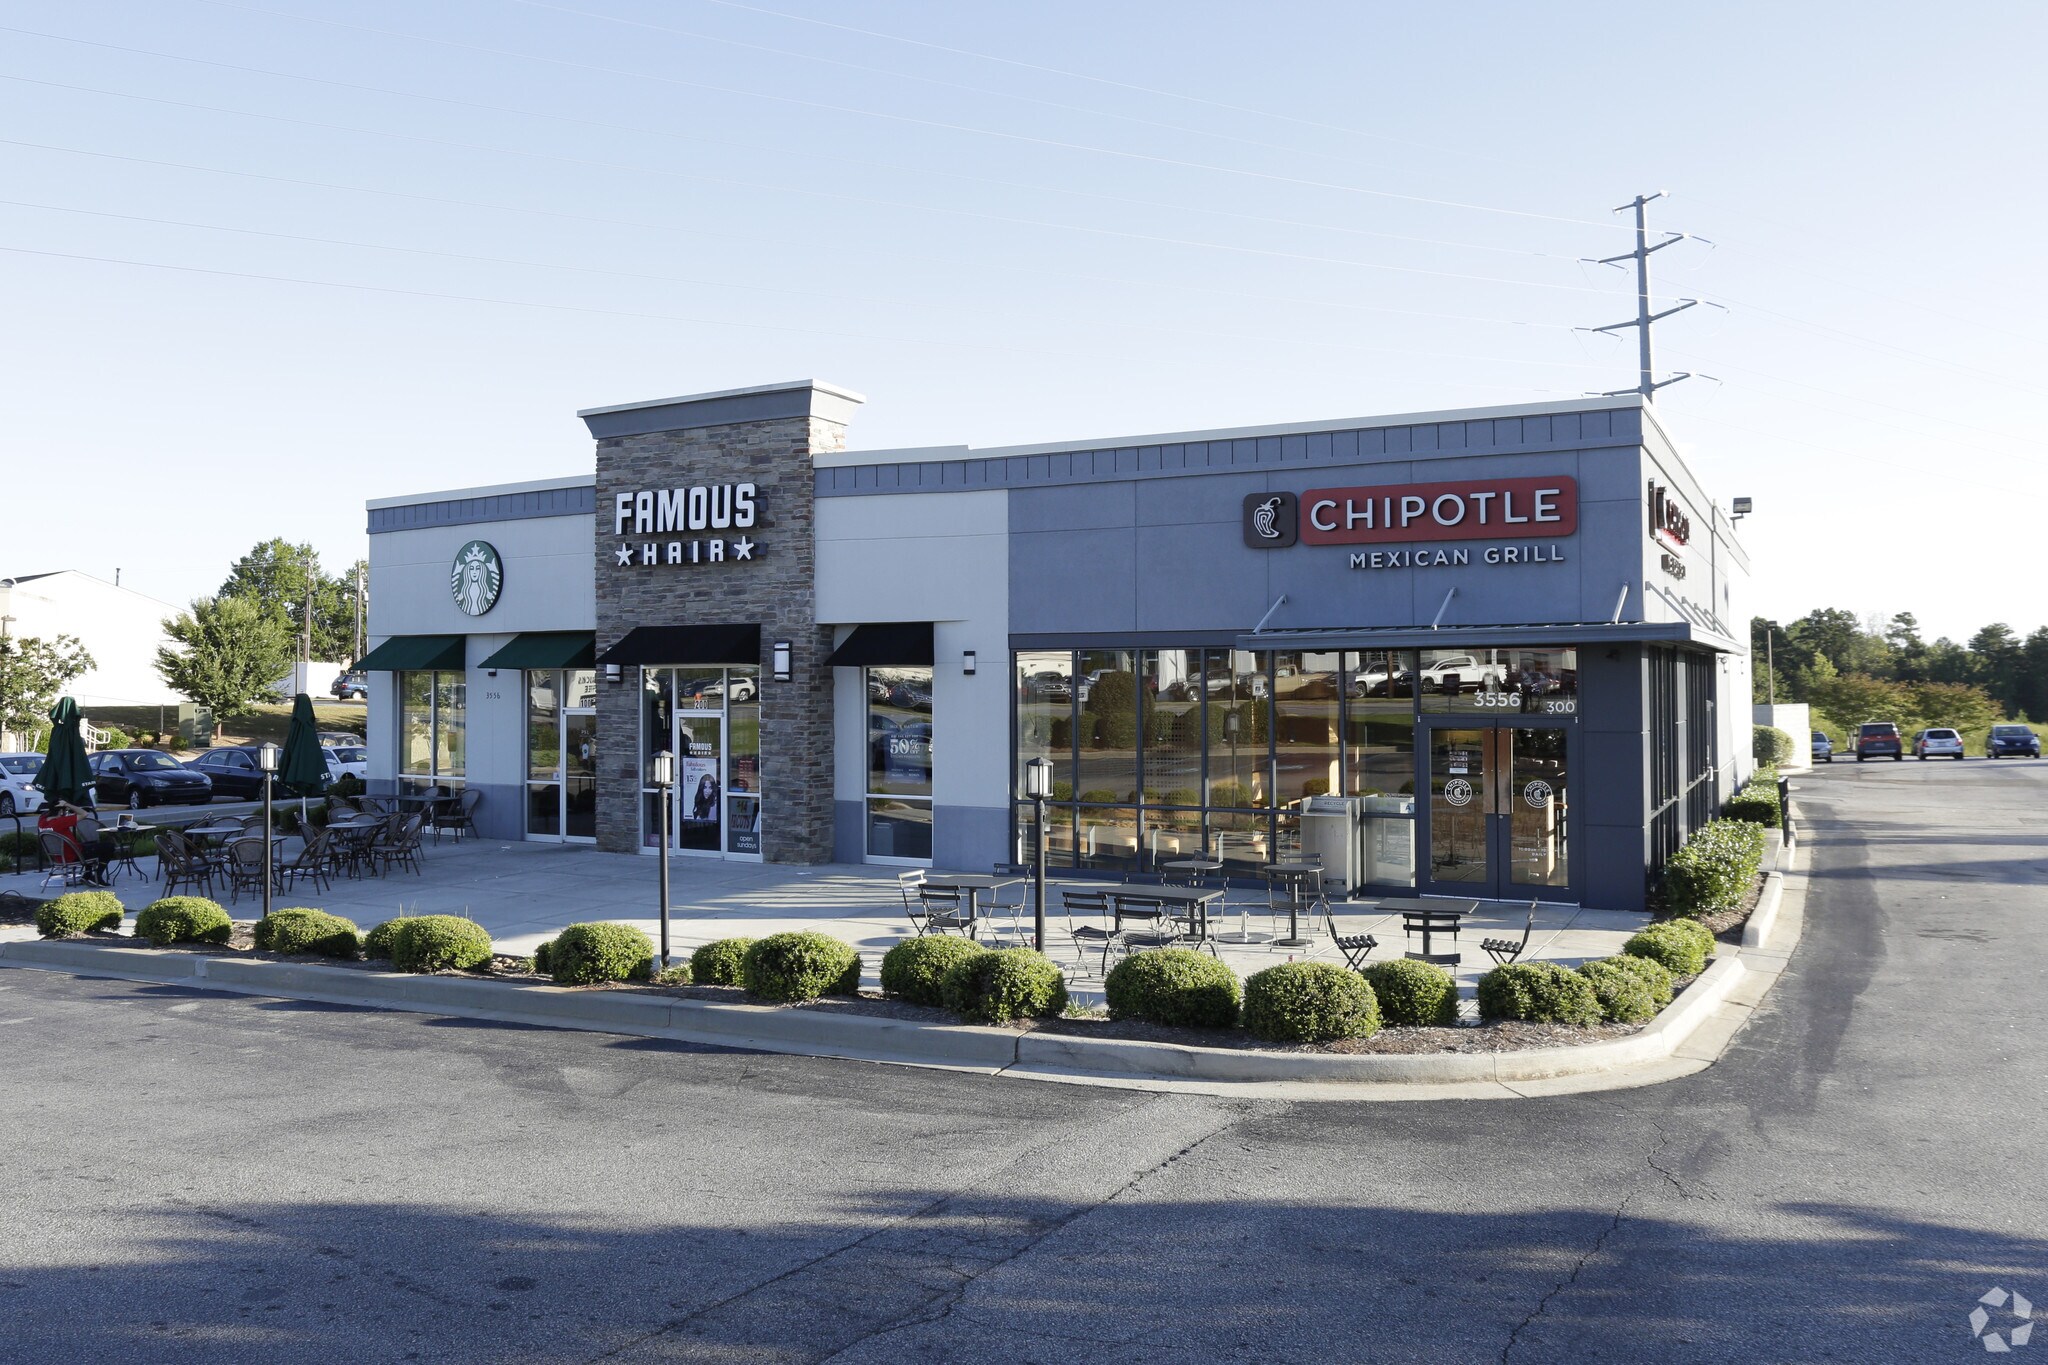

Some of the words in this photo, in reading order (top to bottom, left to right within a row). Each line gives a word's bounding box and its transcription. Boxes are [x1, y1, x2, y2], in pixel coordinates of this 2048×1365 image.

[615, 482, 757, 535] FAMOUS
[1310, 488, 1561, 531] CHIPOTLE
[643, 539, 724, 566] HAIR
[1350, 548, 1469, 569] MEXICAN
[1483, 544, 1565, 565] GRILL
[486, 691, 501, 700] 3556
[1474, 692, 1521, 707] 3556
[1546, 701, 1575, 713] 300
[689, 742, 712, 751] FAMOUS
